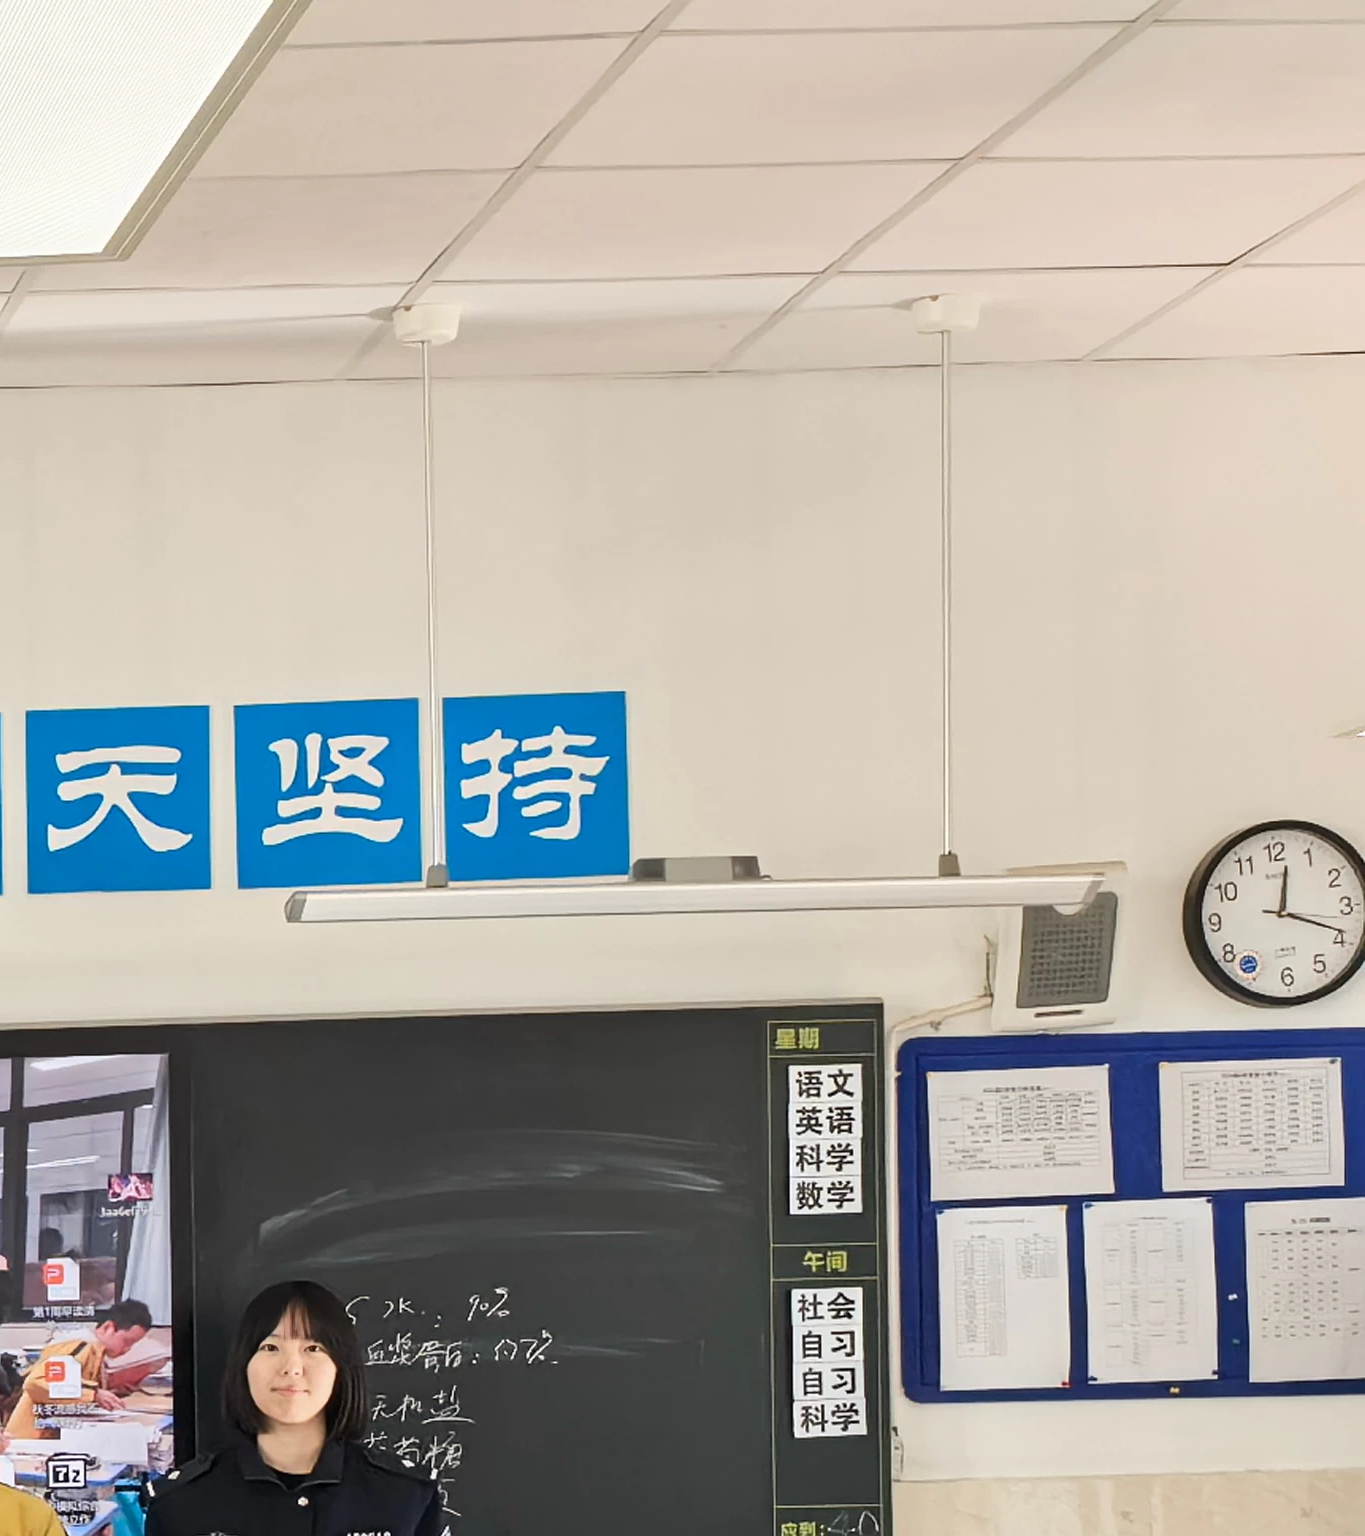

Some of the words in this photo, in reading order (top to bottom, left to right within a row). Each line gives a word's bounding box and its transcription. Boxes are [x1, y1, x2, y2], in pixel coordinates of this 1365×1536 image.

[1264, 841, 1286, 863] 12
[1303, 848, 1313, 867] 1
[1234, 855, 1254, 876] 11
[1328, 868, 1342, 888] 2
[1215, 881, 1238, 902] 10
[1339, 895, 1354, 915] 3
[1208, 912, 1222, 933] 9
[1333, 930, 1346, 947] 4
[1221, 943, 1237, 963] 8
[1313, 954, 1327, 973] 5
[1280, 966, 1295, 987] 6
[774, 1027, 820, 1050] 星期
[795, 1069, 855, 1099] 语文
[795, 1105, 855, 1136] 英语
[795, 1142, 855, 1173] 科学
[795, 1179, 855, 1211] 数学
[802, 1250, 849, 1273] 午间
[797, 1291, 856, 1322] 社会
[800, 1328, 856, 1360] 自习
[800, 1366, 857, 1397] 自习
[800, 1402, 860, 1434] 科学
